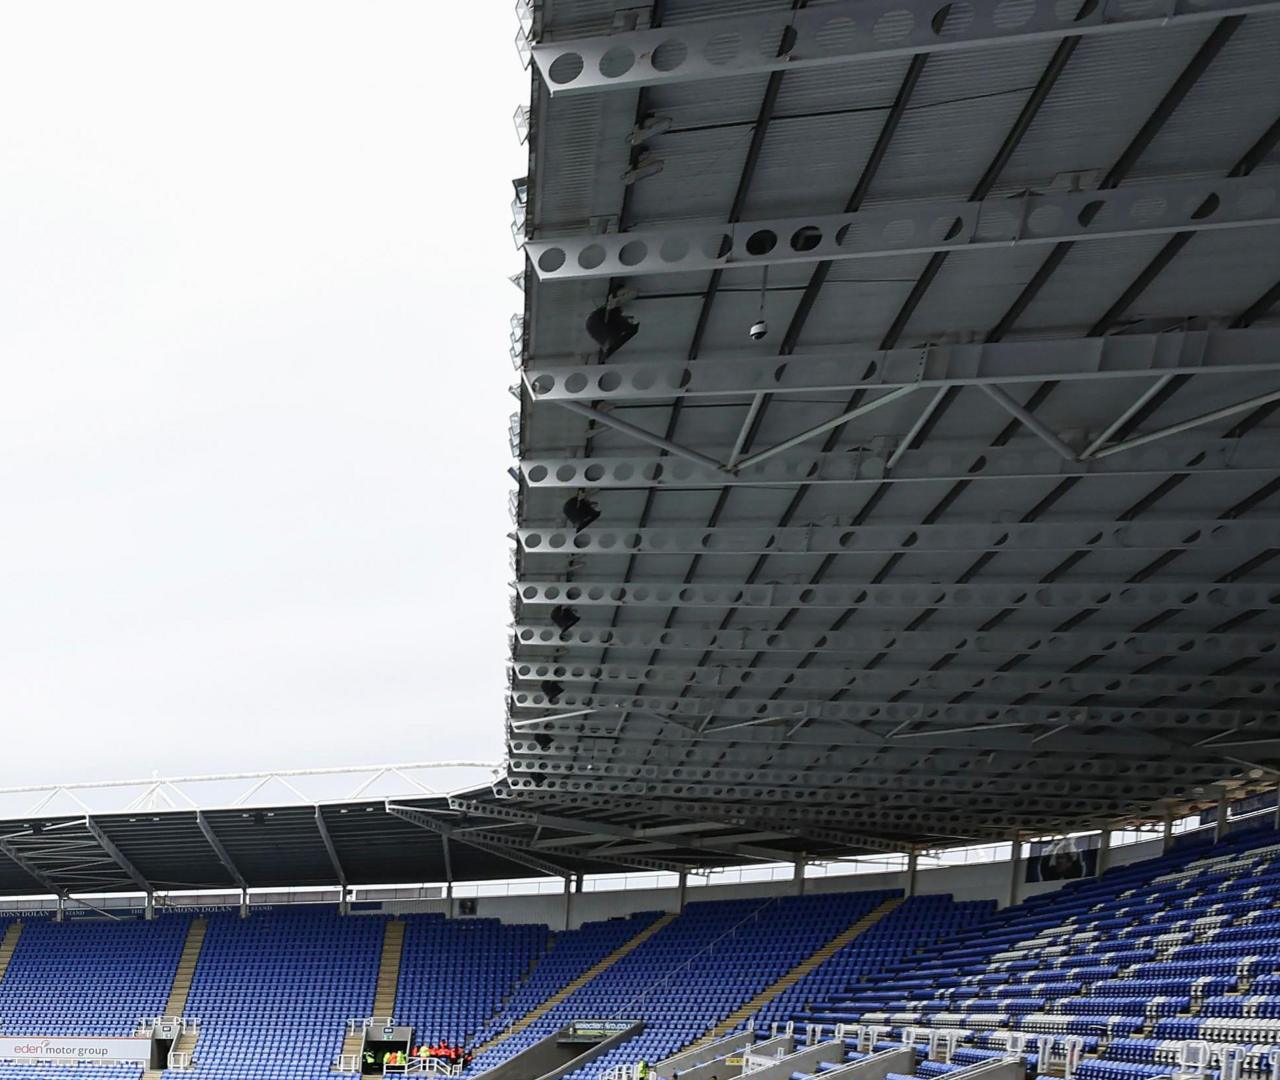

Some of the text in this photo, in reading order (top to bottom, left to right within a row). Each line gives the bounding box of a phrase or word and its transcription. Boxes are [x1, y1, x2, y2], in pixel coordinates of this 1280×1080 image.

[14, 1043, 108, 1056] eden motor group
